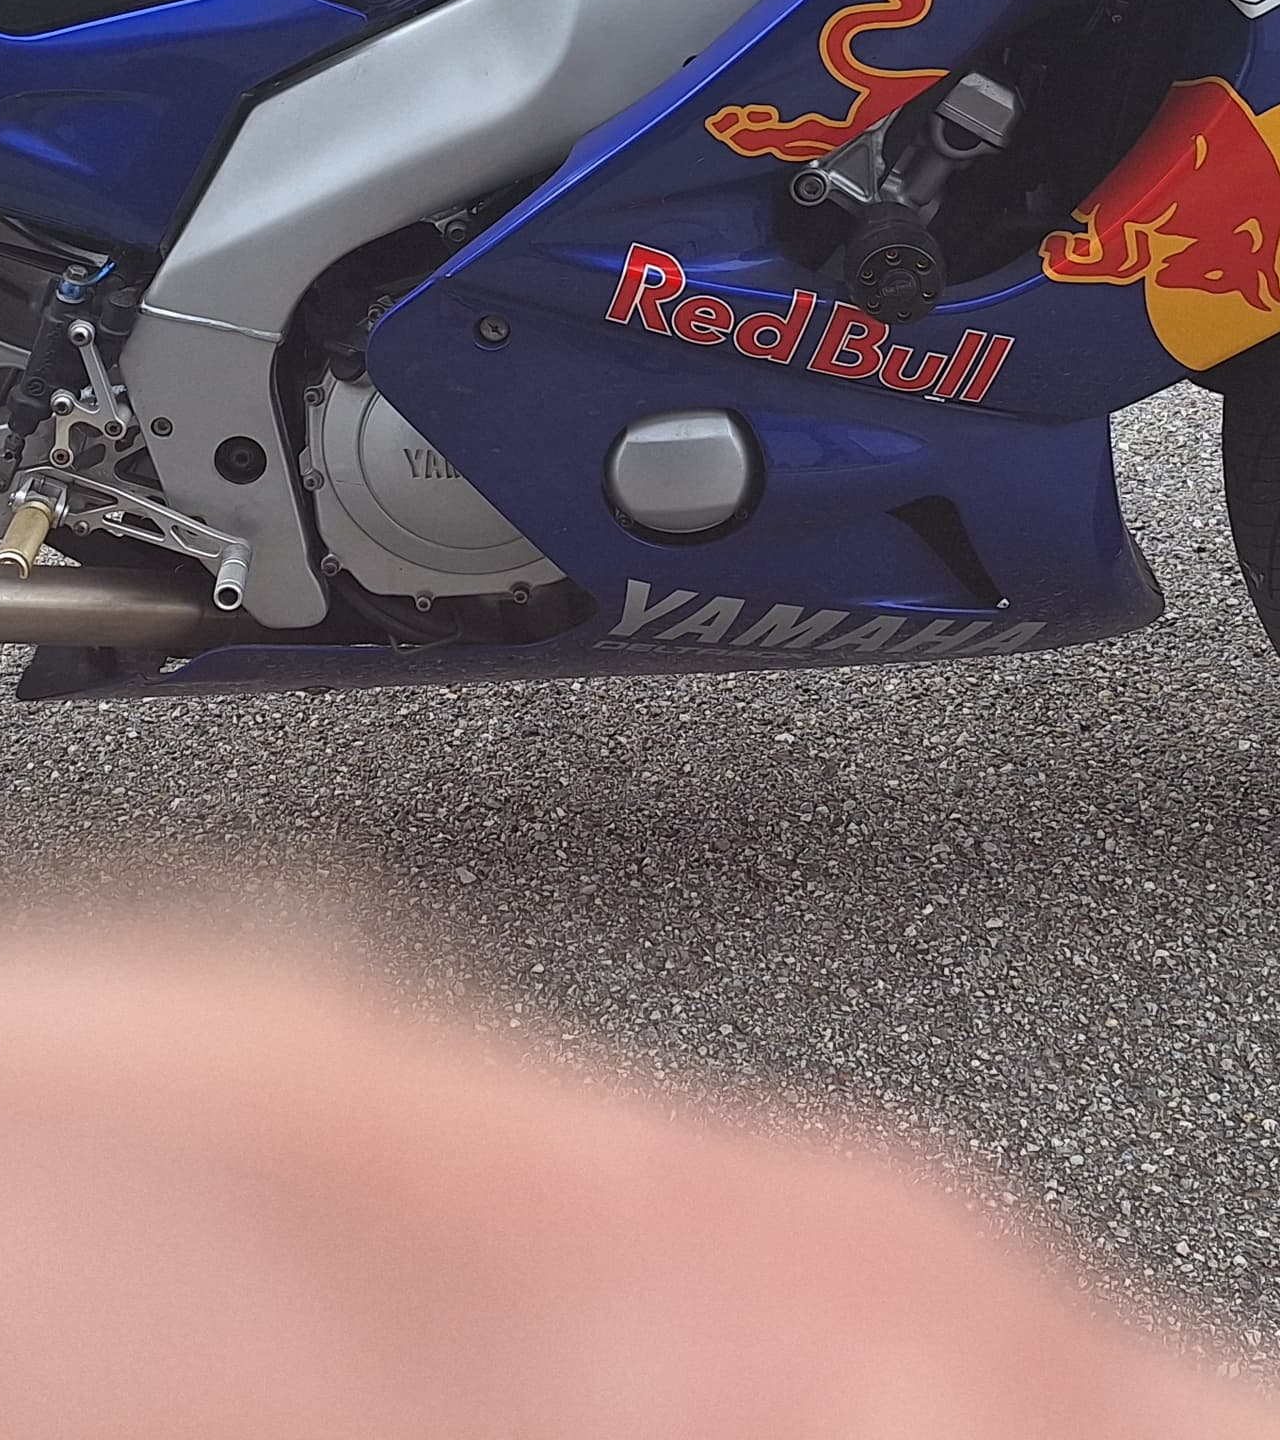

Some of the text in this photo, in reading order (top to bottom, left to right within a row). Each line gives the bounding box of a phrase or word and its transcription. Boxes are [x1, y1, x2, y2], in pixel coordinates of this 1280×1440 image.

[604, 242, 1016, 404] Red Bull
[607, 578, 1049, 655] YAMAHA
